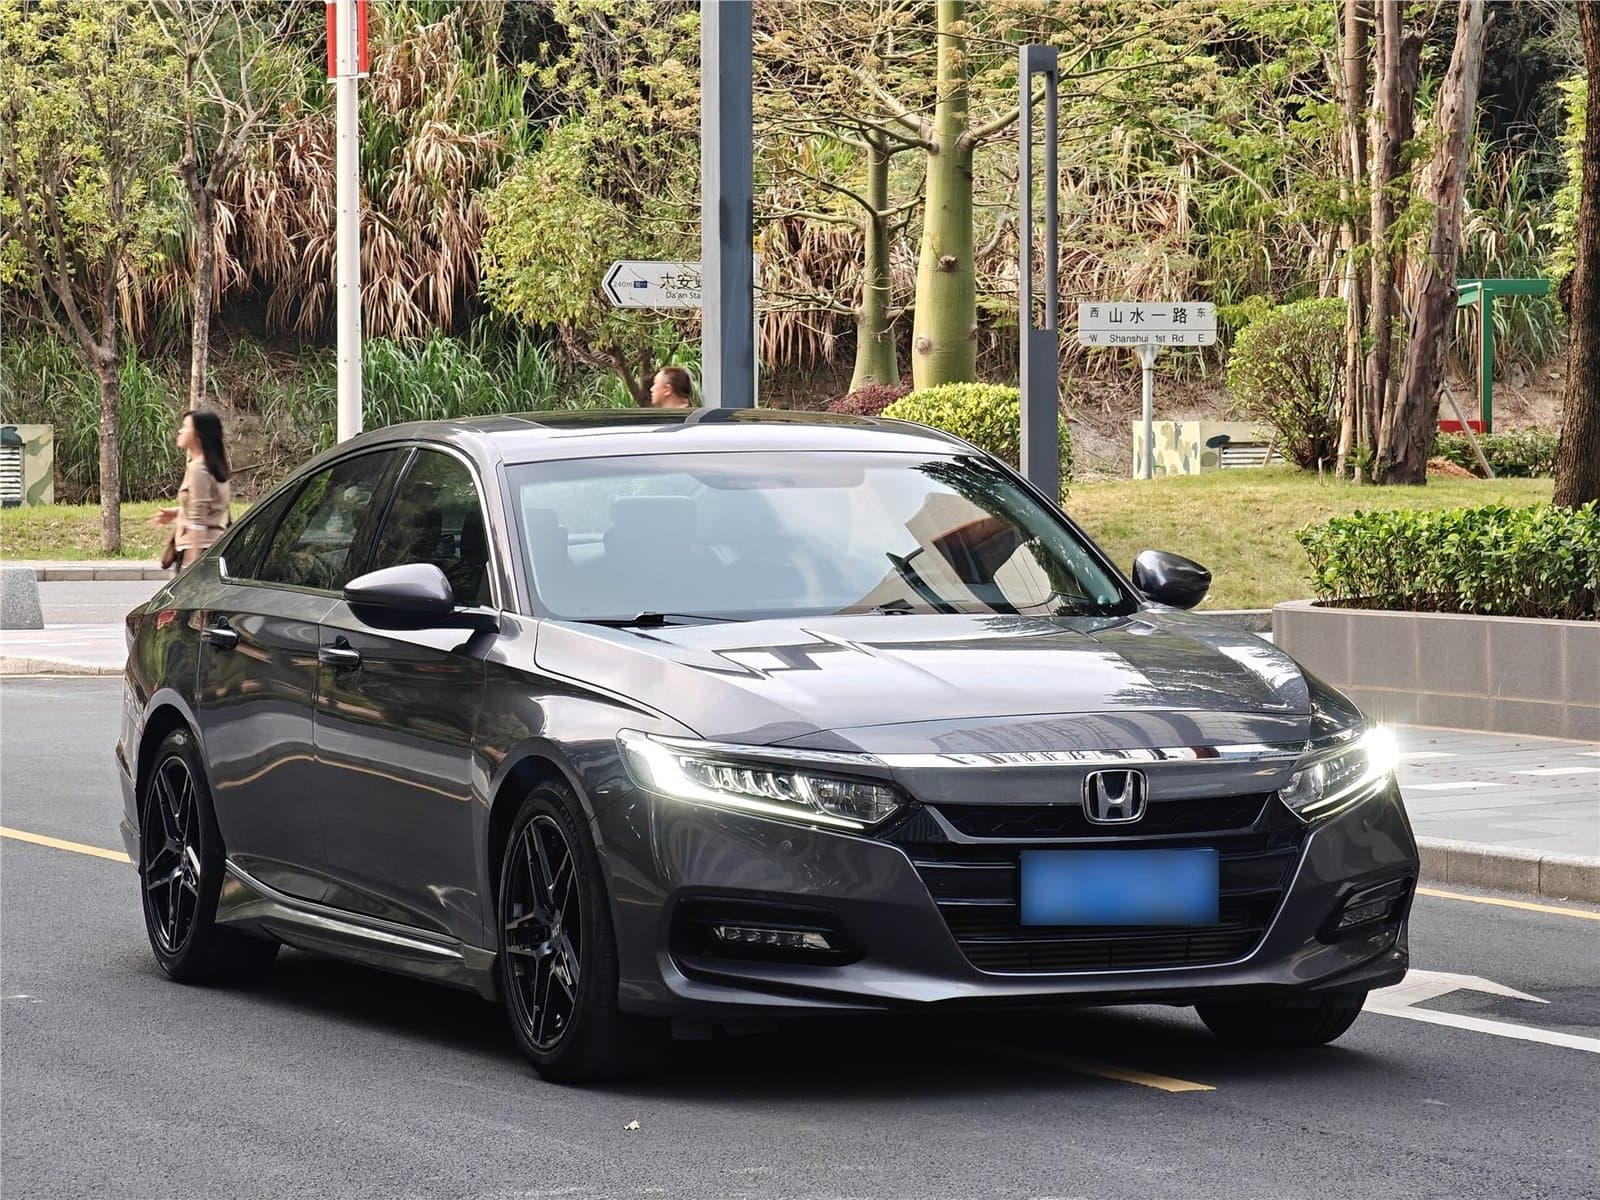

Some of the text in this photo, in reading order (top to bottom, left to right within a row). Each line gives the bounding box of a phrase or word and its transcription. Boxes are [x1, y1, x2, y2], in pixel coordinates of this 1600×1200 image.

[689, 291, 701, 299] Sta
[1090, 307, 1207, 324] 西 山水一路 东
[1090, 334, 1205, 343] W Shanshui 1st Rd E
